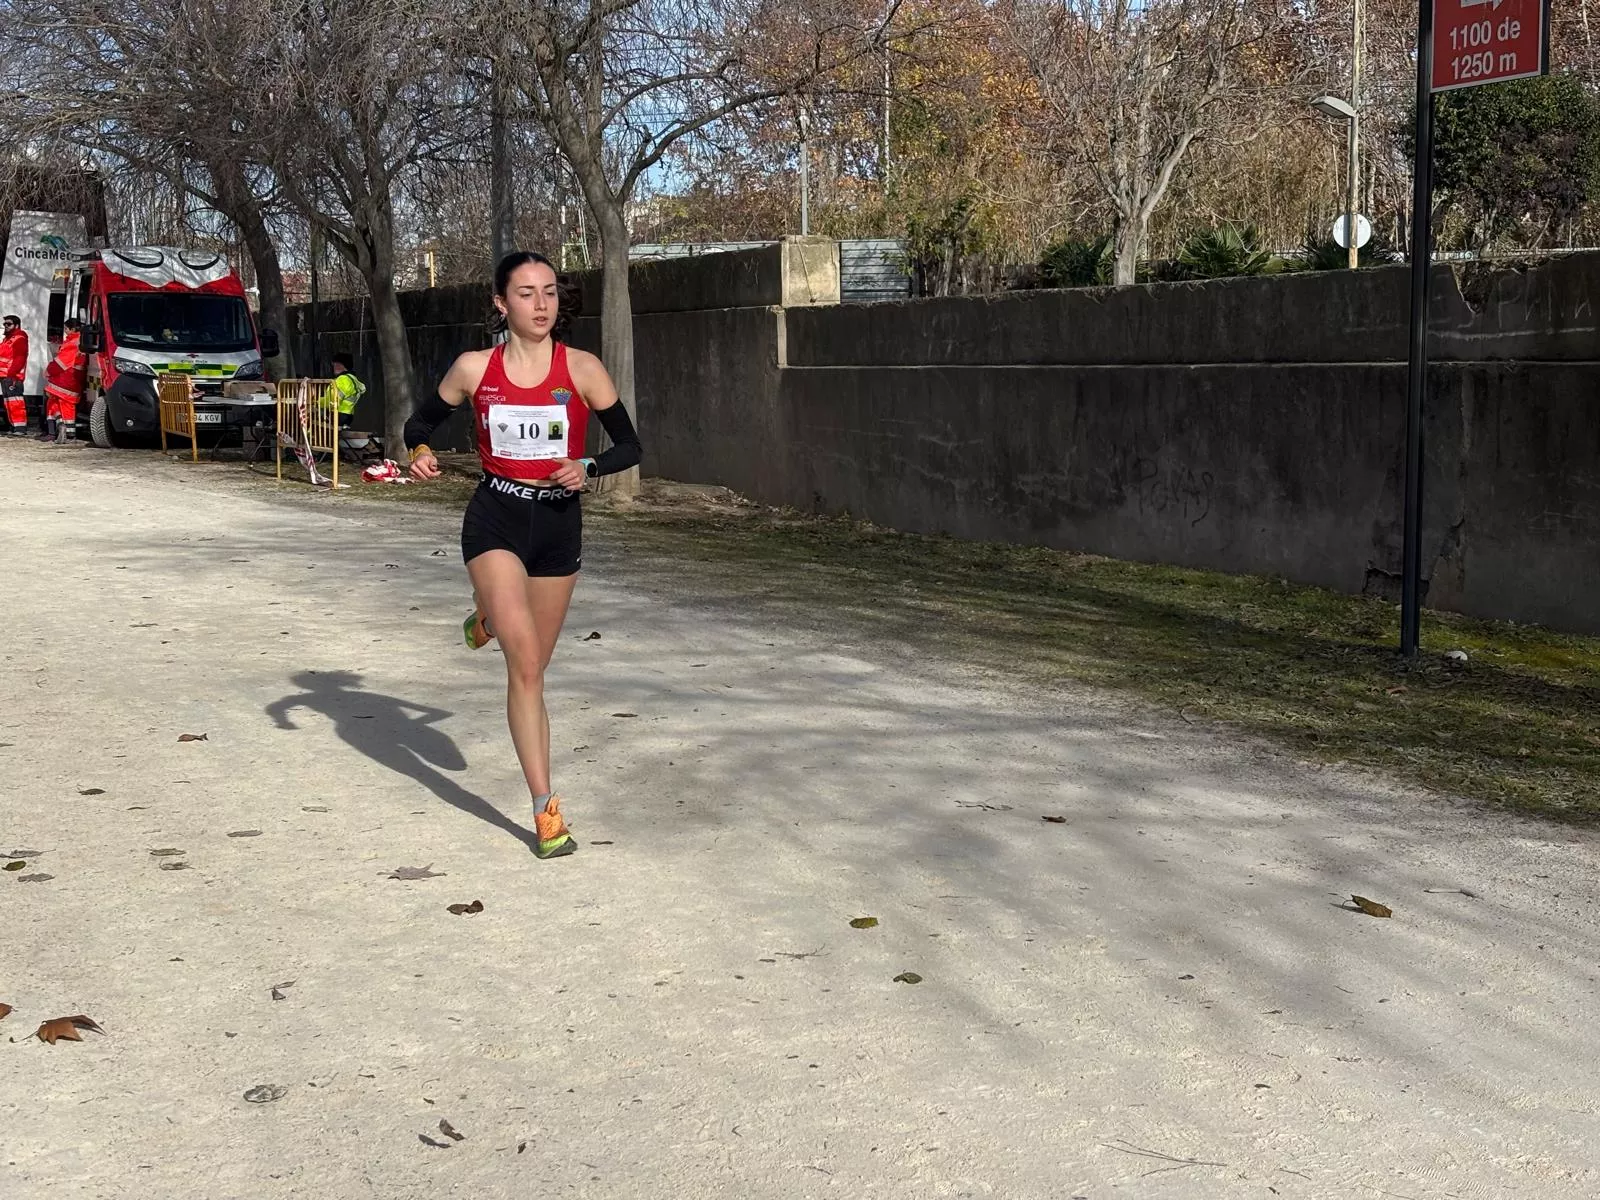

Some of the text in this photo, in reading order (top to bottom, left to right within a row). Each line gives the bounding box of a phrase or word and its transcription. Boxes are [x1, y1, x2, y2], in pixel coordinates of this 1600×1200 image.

[1449, 16, 1521, 50] 1100 de
[1451, 51, 1517, 80] 1250 m
[204, 414, 220, 422] KGV
[517, 422, 540, 440] 10
[489, 477, 536, 500] NIKE
[537, 488, 574, 501] PRO
